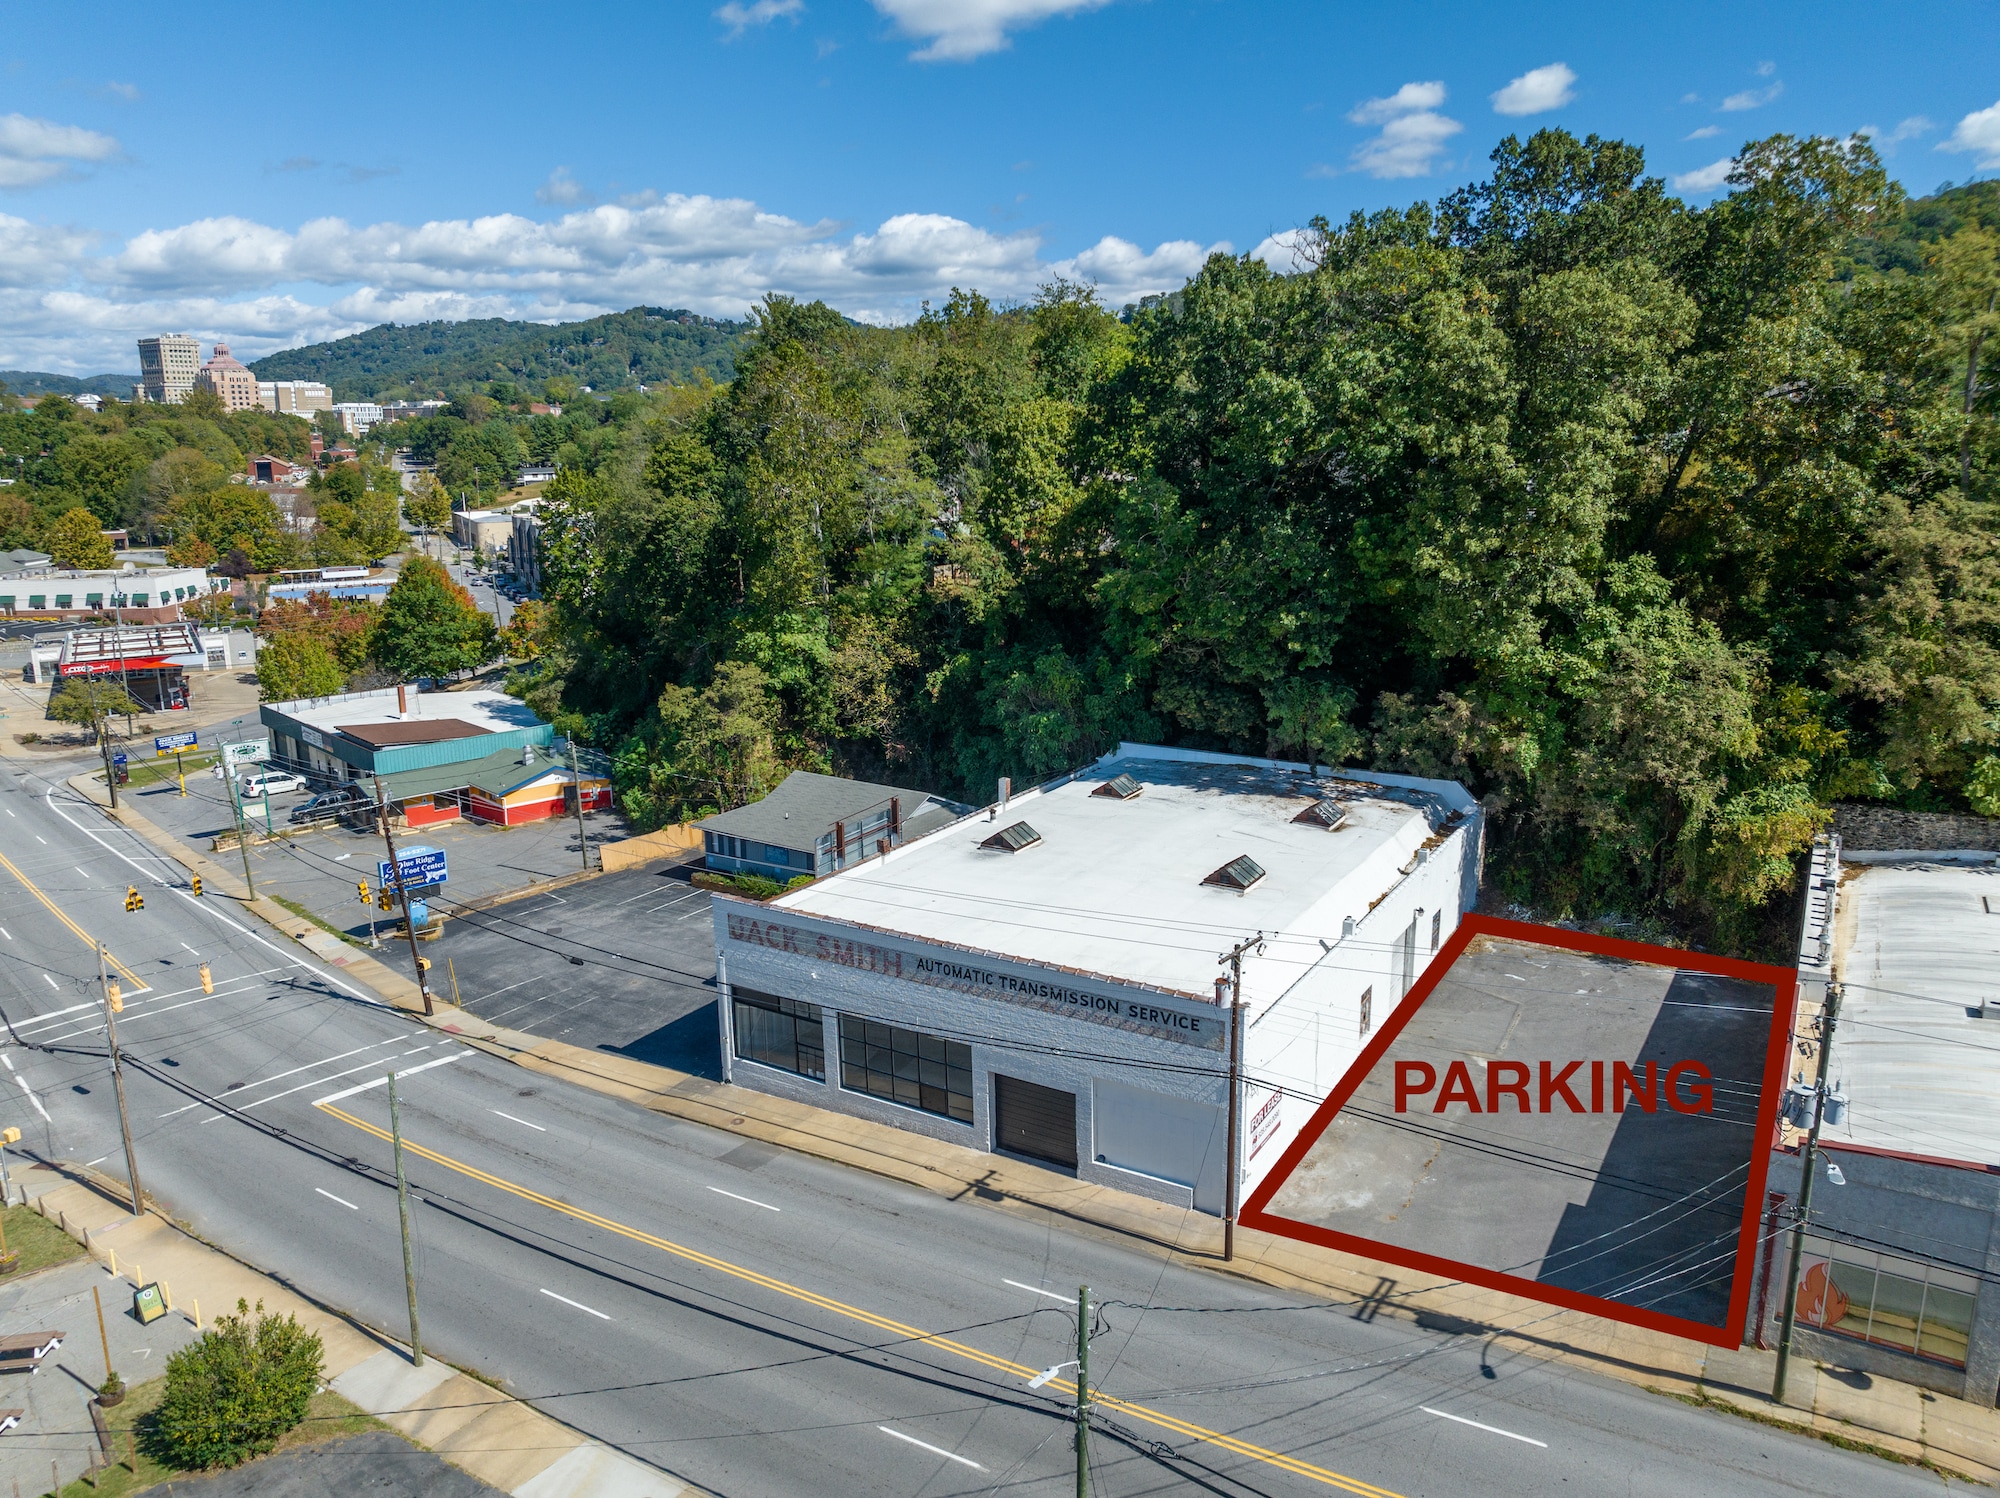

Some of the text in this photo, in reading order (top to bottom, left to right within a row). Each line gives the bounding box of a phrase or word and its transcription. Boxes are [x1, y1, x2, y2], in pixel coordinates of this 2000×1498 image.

[404, 862, 445, 876] Foot Center
[415, 856, 436, 865] Ridge
[730, 919, 901, 978] JACK SMITH
[916, 957, 993, 985] AUTOMATIC
[999, 975, 1119, 1014] TRANSMISSION
[1128, 1004, 1200, 1032] SERVICE
